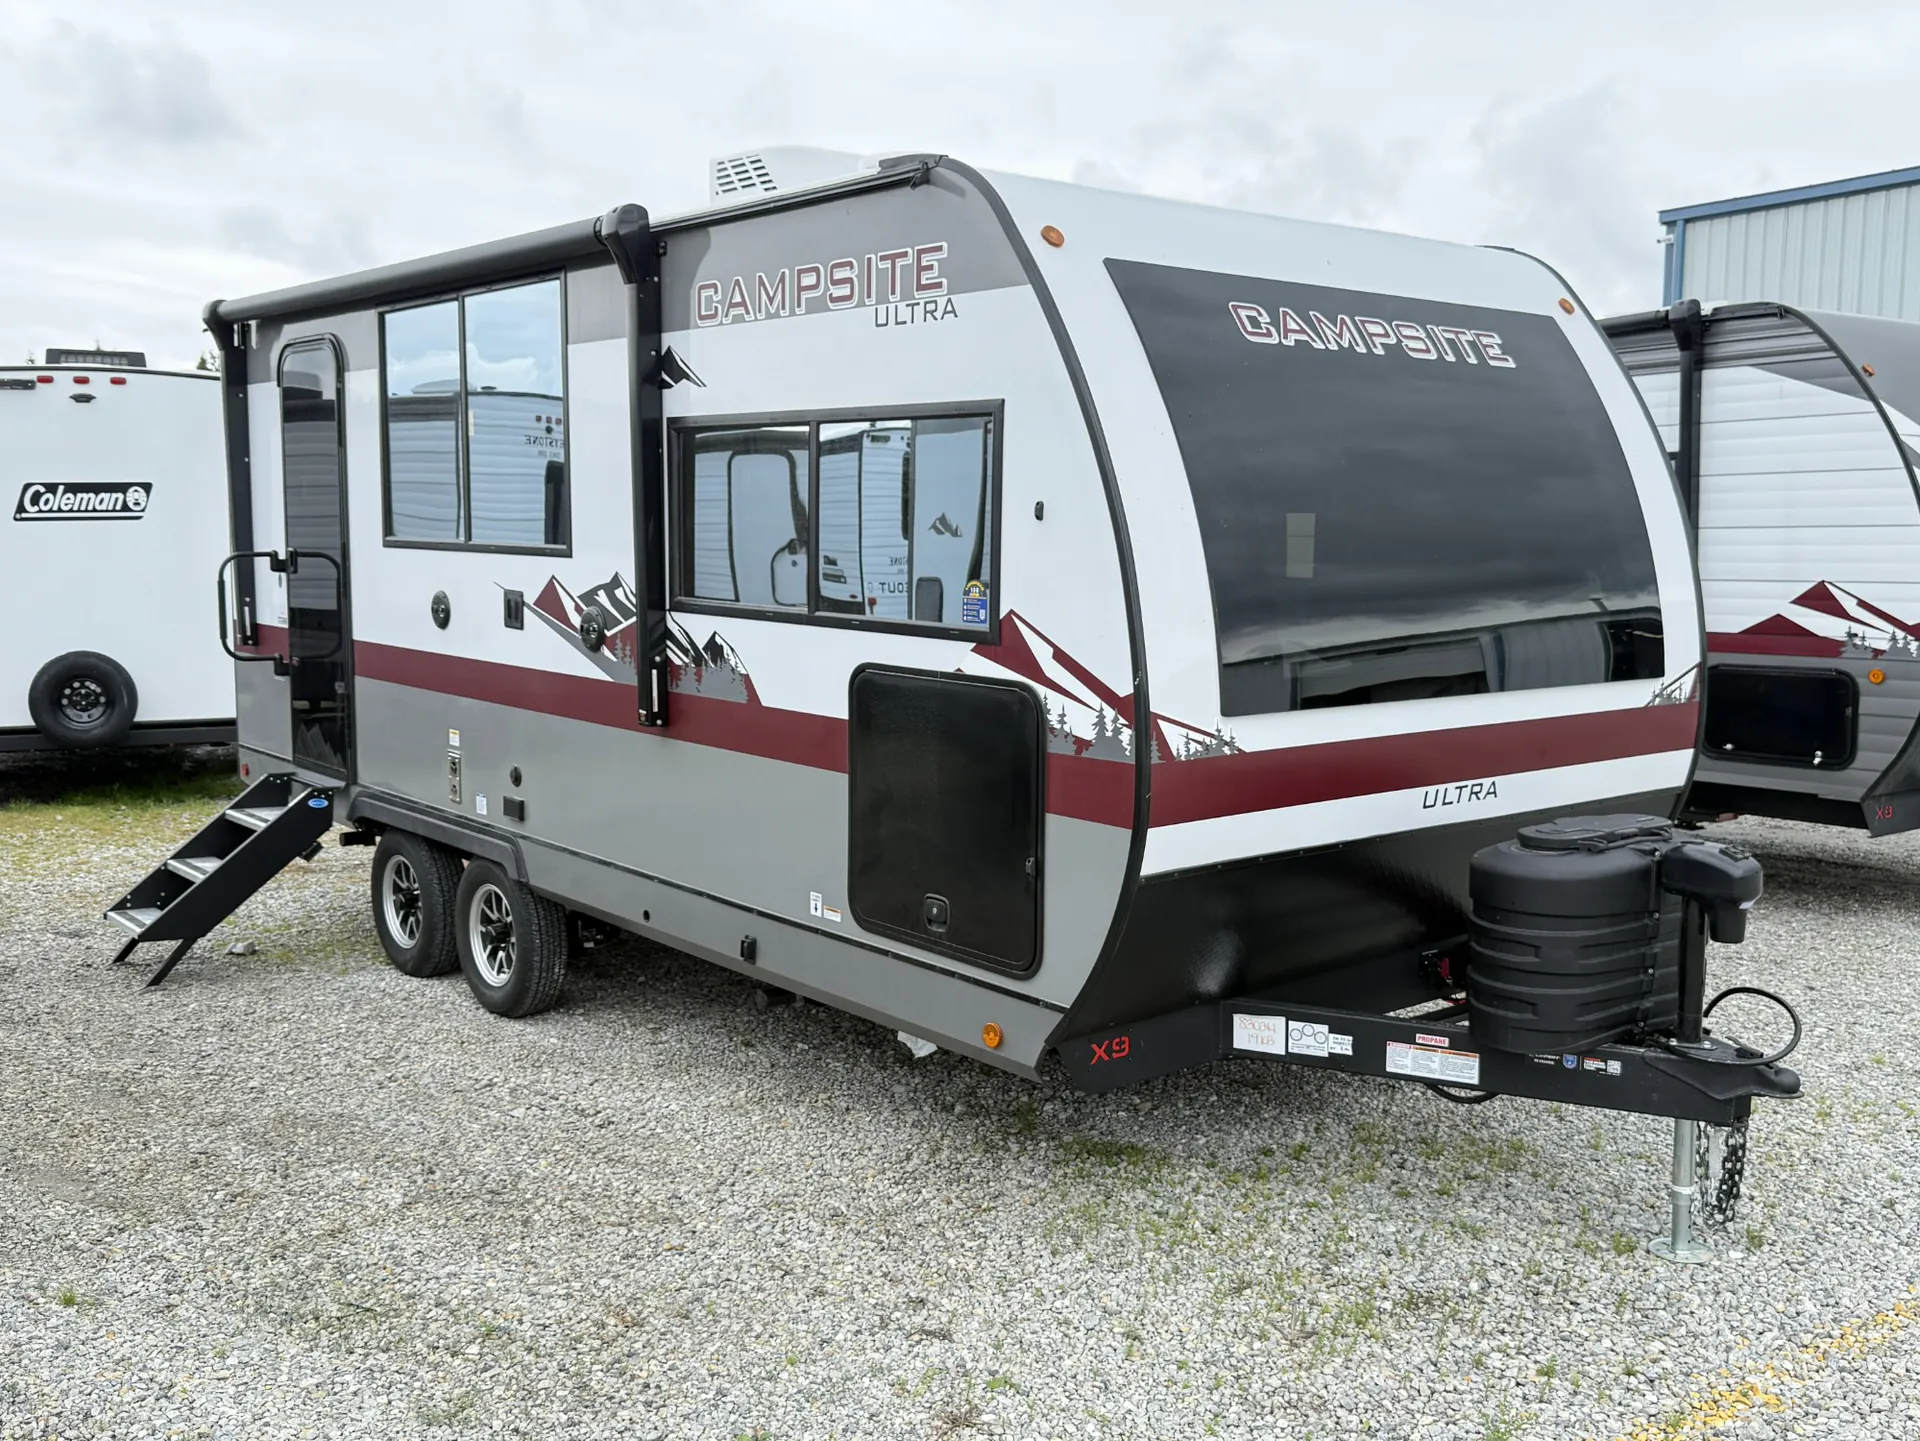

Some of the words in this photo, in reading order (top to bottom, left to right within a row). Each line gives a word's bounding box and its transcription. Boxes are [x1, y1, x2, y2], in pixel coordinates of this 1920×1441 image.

[696, 241, 948, 326] CAMPSITE
[874, 297, 959, 328] ULTRA
[1228, 301, 1517, 368] CAMPSITE
[23, 484, 125, 513] Coleman
[1422, 780, 1498, 809] ULTRA
[1090, 1036, 1130, 1065] X9
[1417, 1034, 1447, 1046] PROPANE
